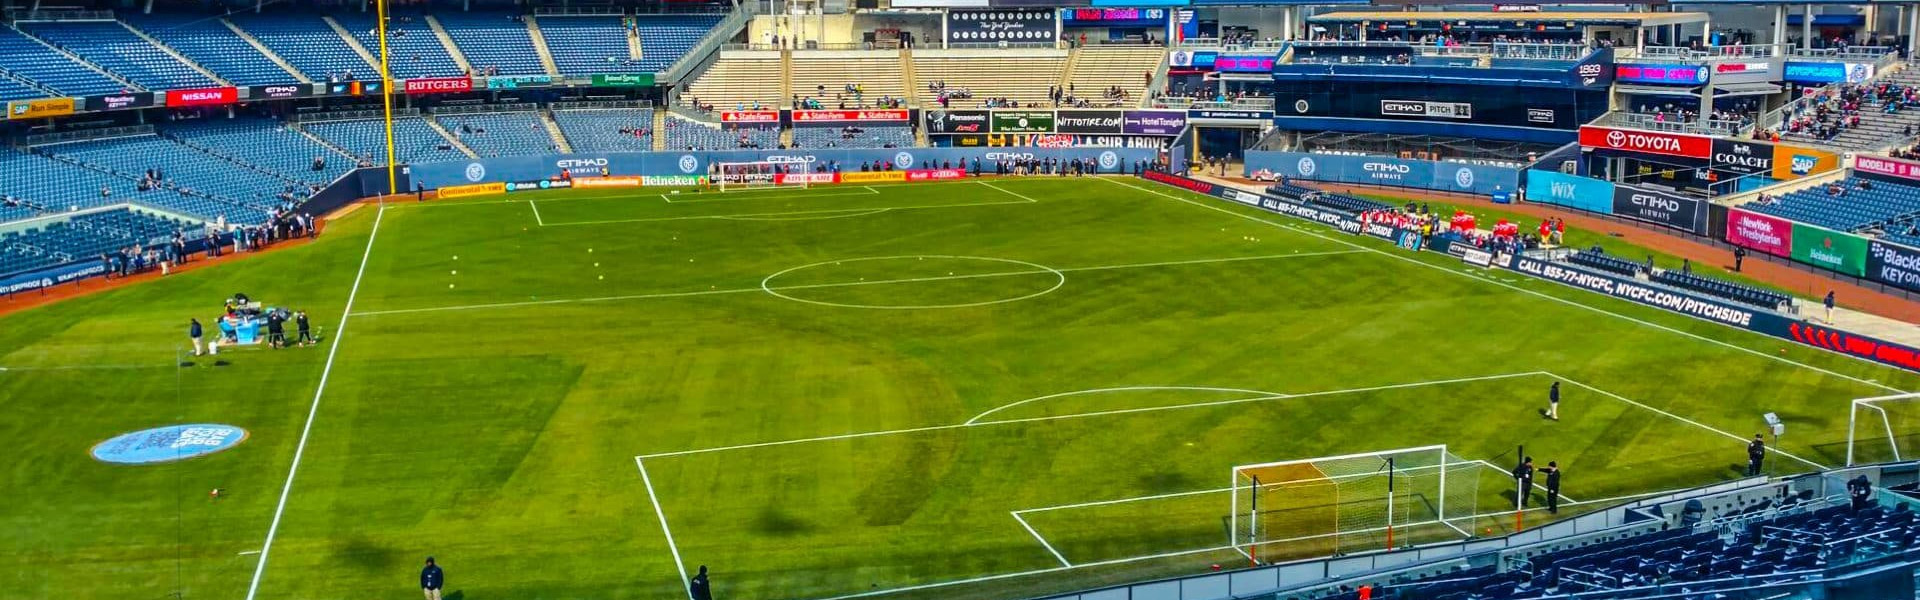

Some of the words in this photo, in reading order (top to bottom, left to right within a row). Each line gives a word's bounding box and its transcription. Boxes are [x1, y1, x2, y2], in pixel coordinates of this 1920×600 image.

[408, 80, 468, 90] RUTGERS
[182, 92, 222, 101] NISSAN
[31, 104, 45, 112] Run
[46, 103, 70, 111] Simple
[1384, 103, 1423, 112] ETIHAD
[1429, 105, 1451, 114] PITCH
[1057, 116, 1121, 127] NITTOTIRE.COM
[1628, 134, 1681, 151] TOYOTA
[767, 155, 816, 163] ETIHAD
[985, 152, 1034, 161] ETIHAD
[1716, 153, 1768, 169] COACH
[557, 158, 608, 168] ETIHAD
[1363, 162, 1410, 174] ETIHAD
[1792, 157, 1815, 172] SAP
[642, 176, 696, 186] Heineken
[1696, 168, 1718, 182] FedEx
[1631, 193, 1679, 212] ETIHAD
[1639, 207, 1671, 221] AIRWAYS
[1809, 248, 1843, 266] Heineken
[1881, 265, 1920, 285] KEYon
[1518, 259, 1542, 275] CALL
[1543, 265, 1614, 294] 855-77-NYCFC,
[1616, 282, 1752, 326] NYCFC.COM/PITCHSIDE
